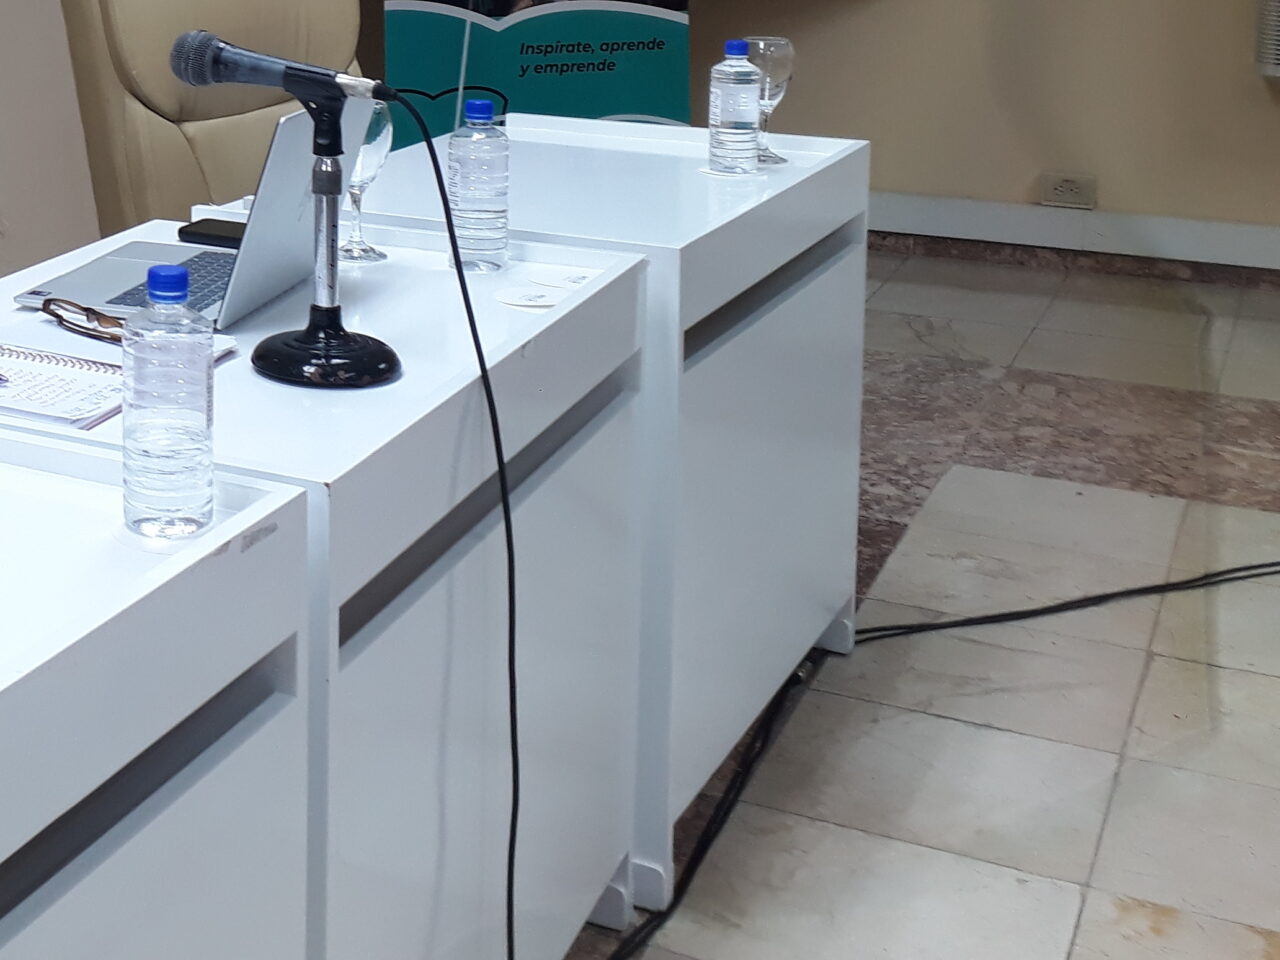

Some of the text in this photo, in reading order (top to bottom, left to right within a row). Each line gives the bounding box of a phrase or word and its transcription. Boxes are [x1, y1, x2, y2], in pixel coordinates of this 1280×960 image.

[599, 37, 666, 55] aprende
[518, 59, 617, 78] y emprende
